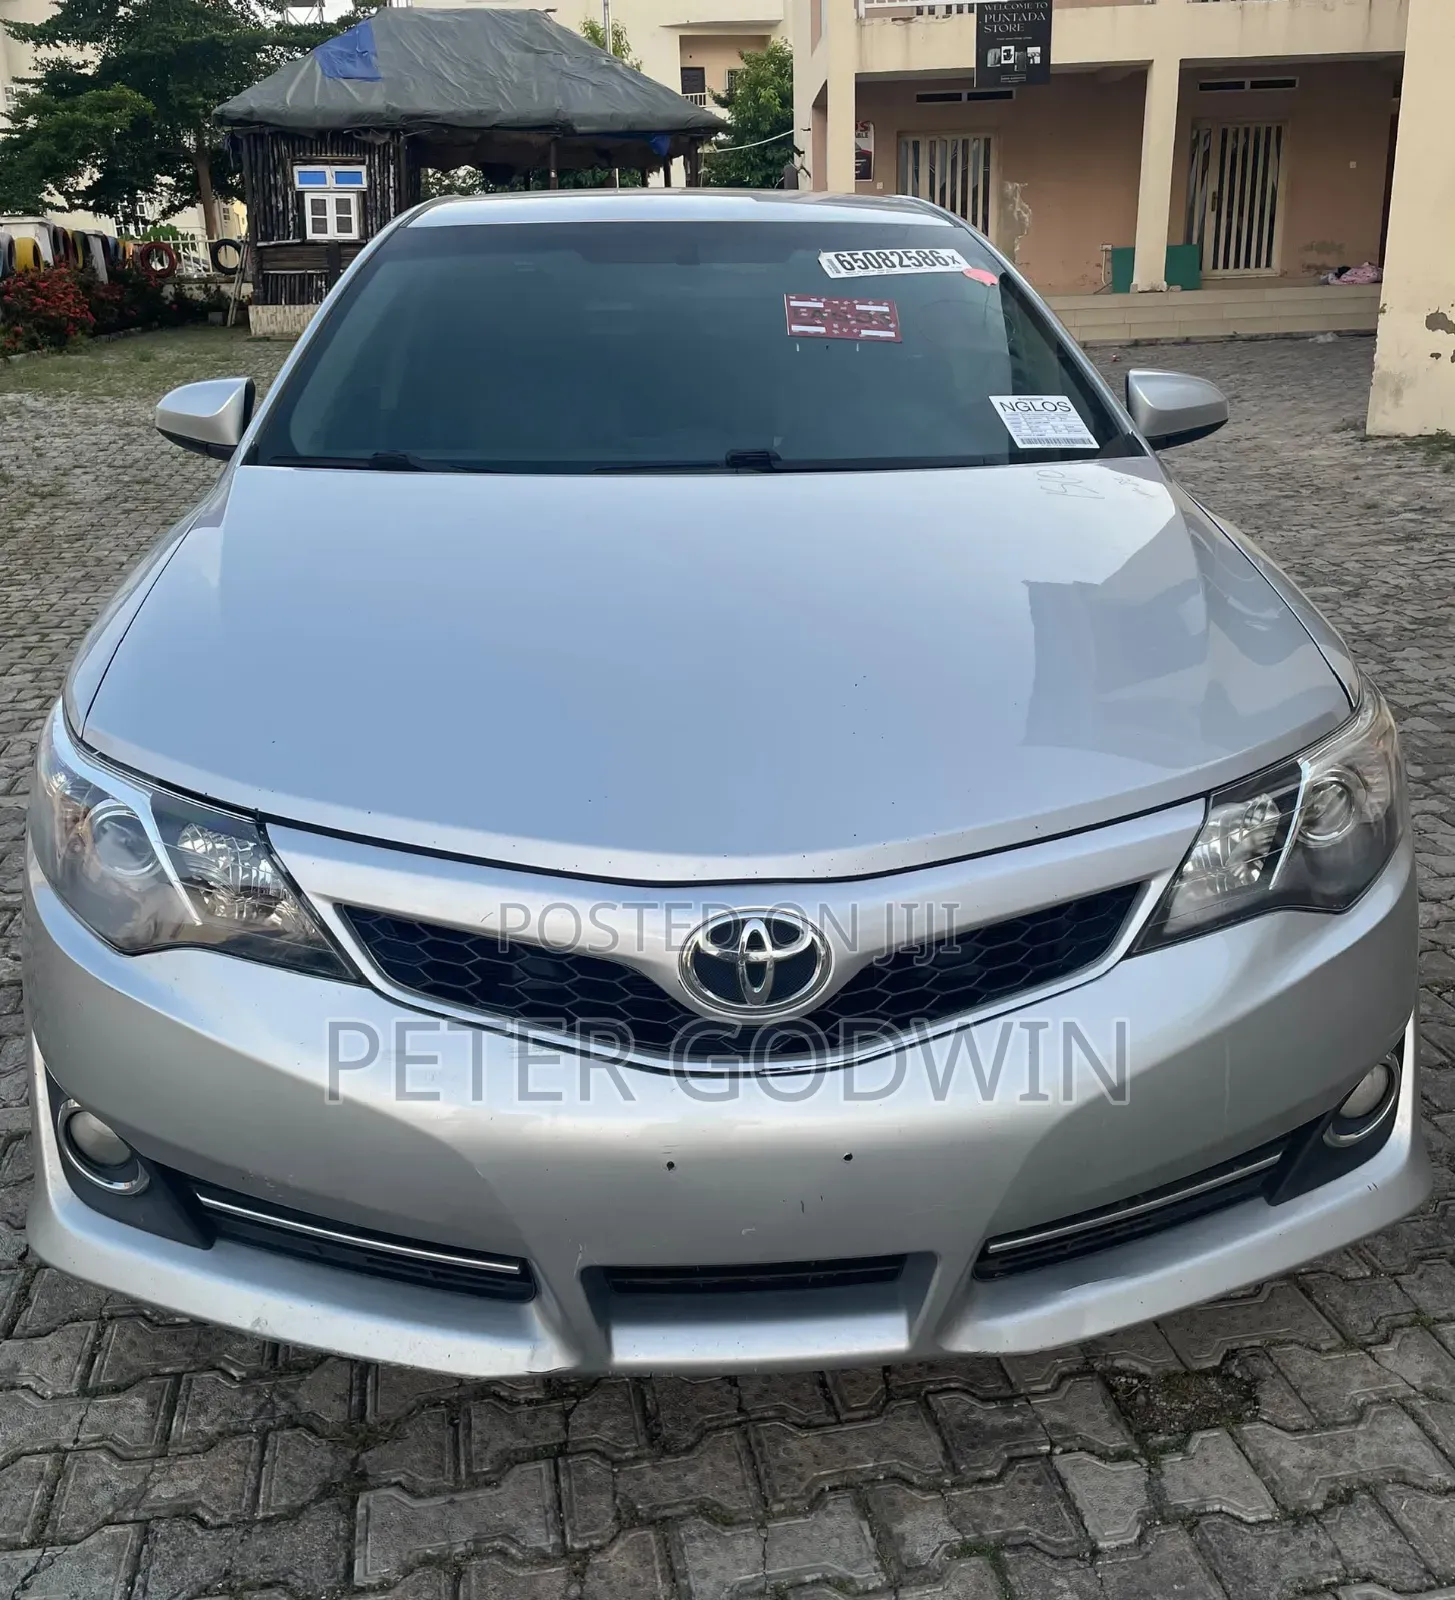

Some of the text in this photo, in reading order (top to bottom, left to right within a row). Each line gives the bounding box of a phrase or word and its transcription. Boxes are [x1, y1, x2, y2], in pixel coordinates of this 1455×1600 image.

[984, 3, 1032, 11] WELCOME
[984, 12, 1046, 23] PUNTADA
[984, 23, 1025, 33] STORE
[999, 401, 1071, 412] NGLOS
